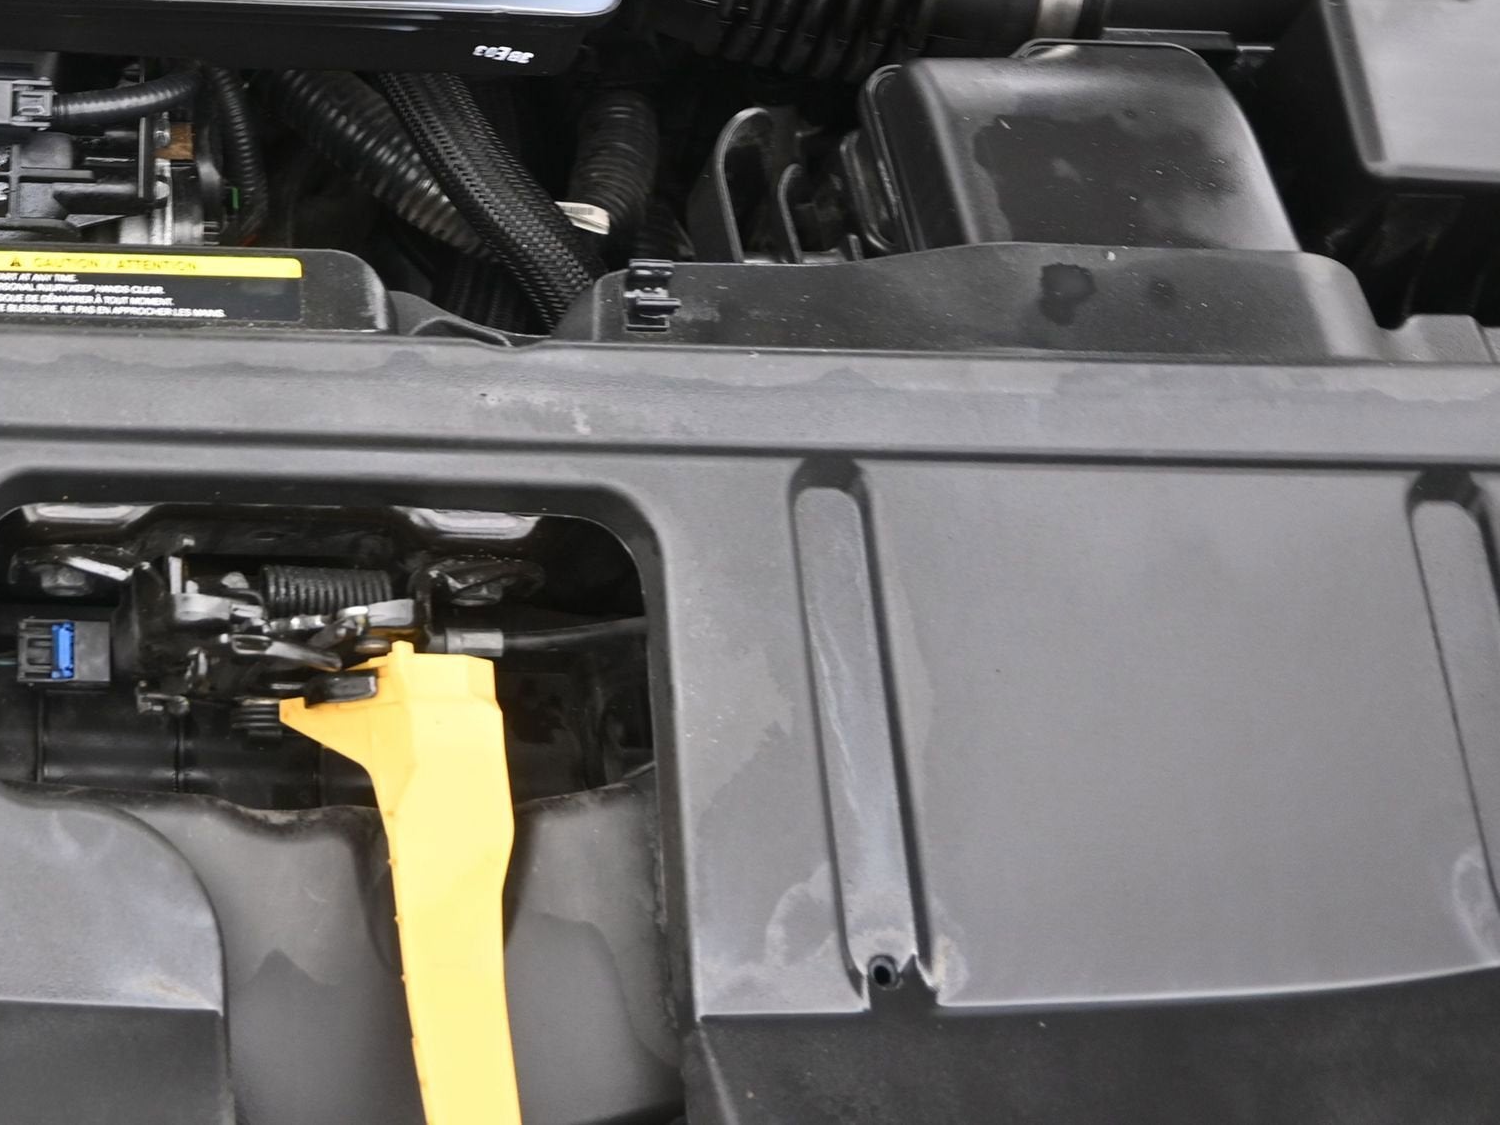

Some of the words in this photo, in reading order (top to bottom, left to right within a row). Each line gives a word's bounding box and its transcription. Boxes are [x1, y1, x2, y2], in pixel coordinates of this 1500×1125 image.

[33, 256, 98, 269] CAUTION
[116, 259, 197, 271] ATTENTION
[18, 272, 32, 282] AT
[31, 272, 52, 282] ANY
[67, 283, 95, 293] KEEP
[95, 284, 131, 294] HANDS
[24, 293, 39, 303] DE
[102, 294, 129, 305] TOUT
[60, 304, 75, 314] NE
[75, 305, 96, 315] PAS
[96, 305, 112, 315] EN
[112, 306, 177, 317] APPROCHER
[177, 307, 192, 317] LES
